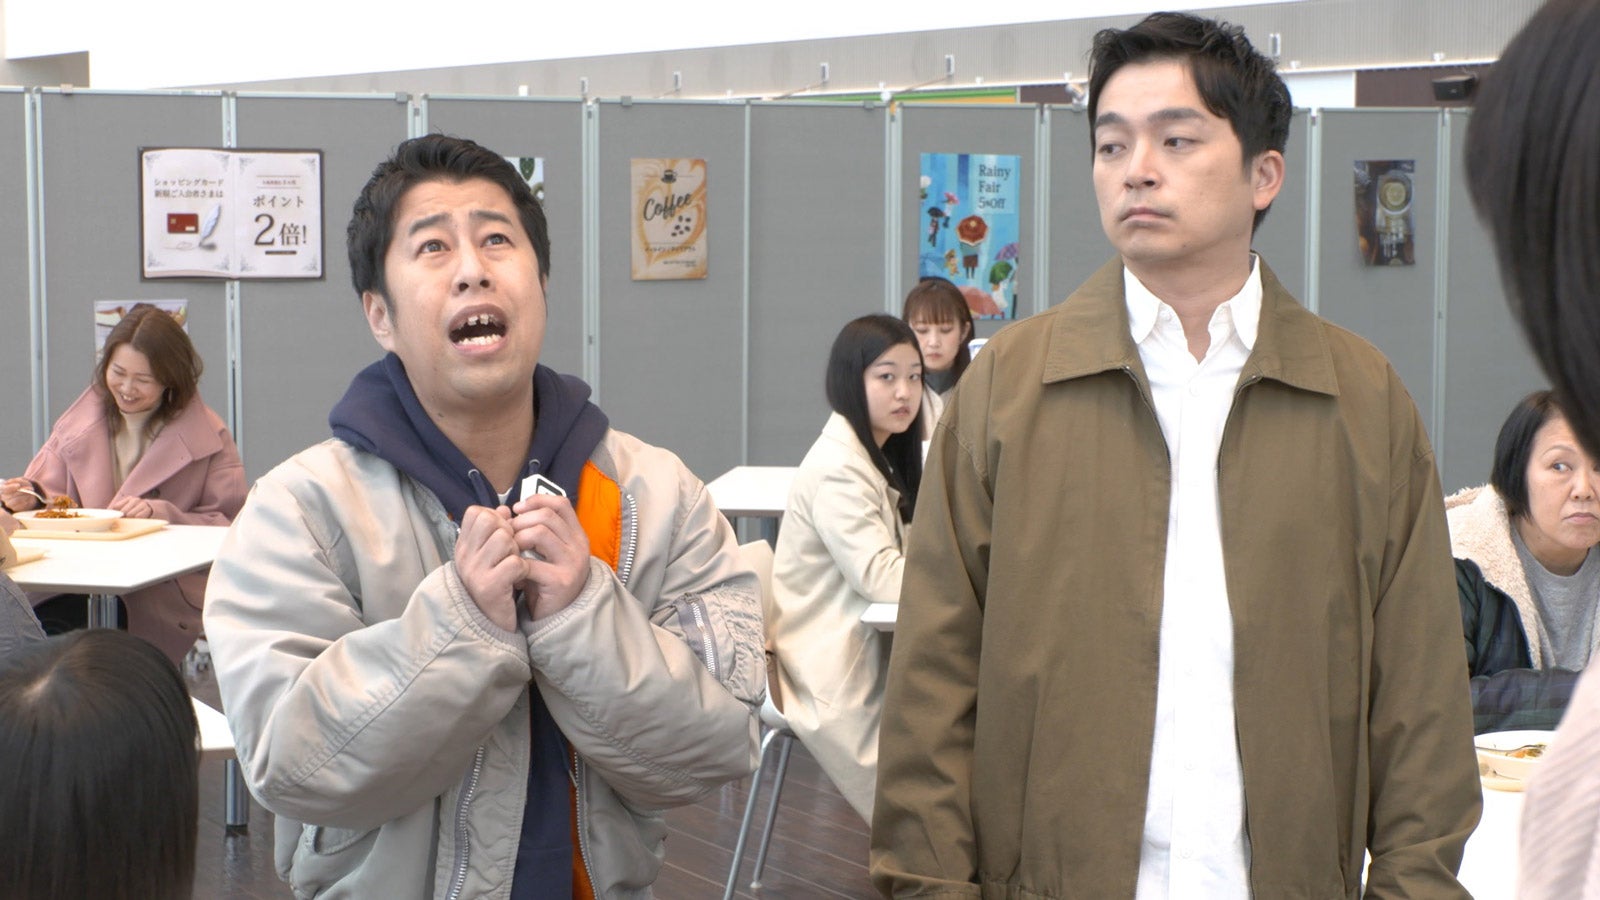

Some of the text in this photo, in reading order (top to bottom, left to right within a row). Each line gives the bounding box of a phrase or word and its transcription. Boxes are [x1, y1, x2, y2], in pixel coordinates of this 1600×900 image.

[979, 164, 1011, 181] Rainy
[979, 180, 1001, 193] Fair
[253, 195, 304, 208] ポイント
[643, 193, 692, 221] Coffee
